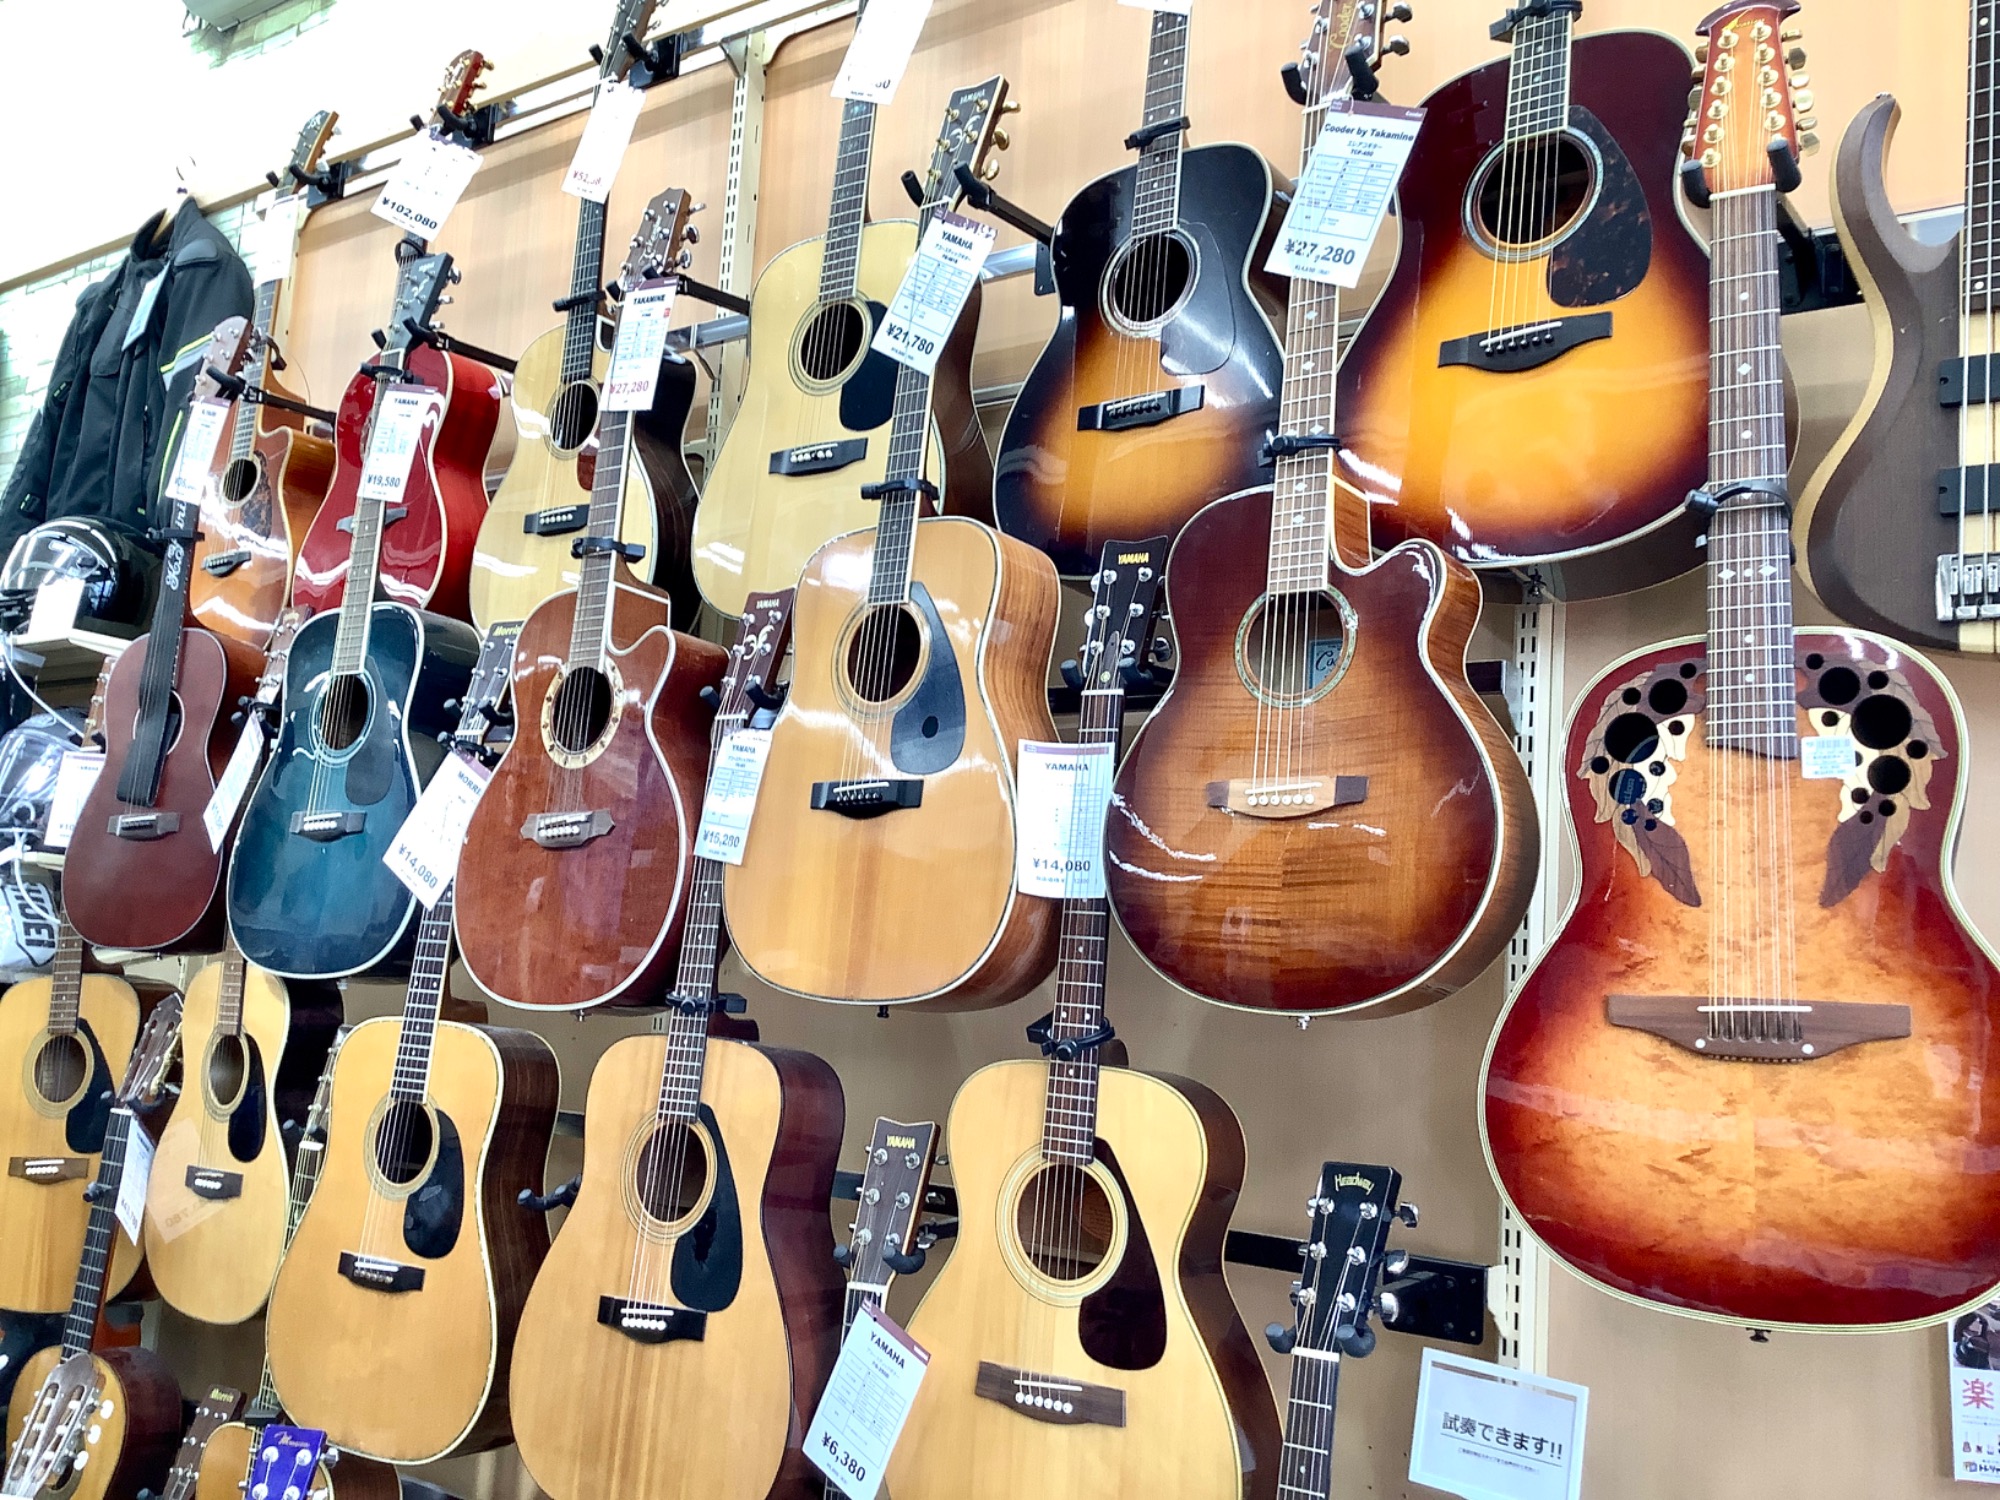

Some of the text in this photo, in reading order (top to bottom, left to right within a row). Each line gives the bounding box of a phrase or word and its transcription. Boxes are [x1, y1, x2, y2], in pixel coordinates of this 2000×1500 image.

[1324, 123, 1415, 142] Cooder by Takamine
[381, 196, 438, 230] ¥102,080
[941, 230, 974, 251] YAMAHA
[1283, 238, 1356, 266] ¥27,280
[633, 293, 666, 306] TAKAMINE
[885, 321, 935, 356] ¥21,780
[609, 380, 650, 395] ¥27,280
[394, 397, 419, 407] YAMAHA
[367, 473, 401, 489] ¥19,580
[1118, 551, 1150, 566] YAMAHA
[731, 743, 757, 754] YAMAHA
[1044, 762, 1090, 772] YAMAHA
[457, 770, 482, 796] MORRI
[398, 843, 438, 890] ¥14,080
[1032, 857, 1091, 873] ¥14,080
[886, 1134, 915, 1150] YAMAHA
[1334, 1171, 1375, 1196] Headway
[869, 1330, 906, 1370] YAMAHA
[1962, 1378, 1995, 1410] 楽
[1441, 1411, 1563, 1461] 試奏できます!!
[820, 1430, 867, 1483] ¥6,380
